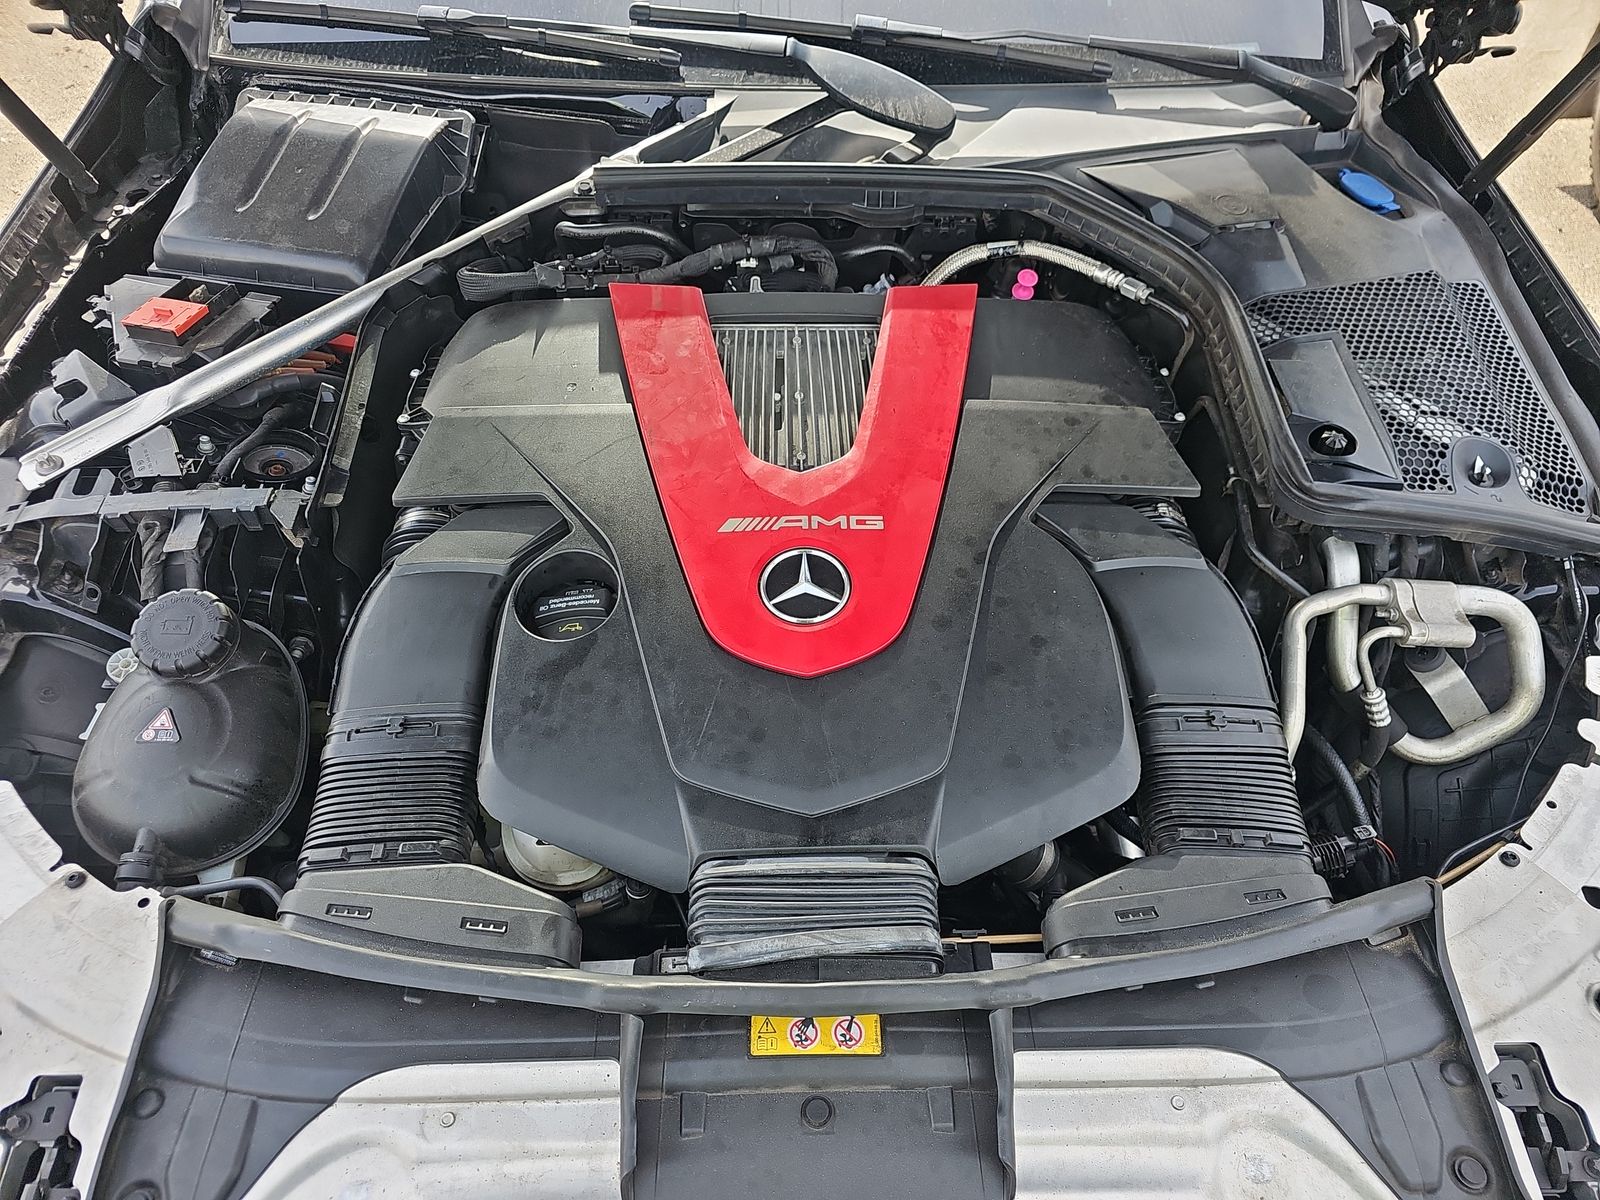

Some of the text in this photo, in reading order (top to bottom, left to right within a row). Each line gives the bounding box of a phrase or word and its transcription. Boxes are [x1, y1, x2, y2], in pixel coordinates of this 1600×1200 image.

[771, 515, 885, 530] AMG
[170, 596, 190, 605] OPEN
[549, 594, 595, 604] recommended
[550, 599, 600, 608] Mercedes-Benz
